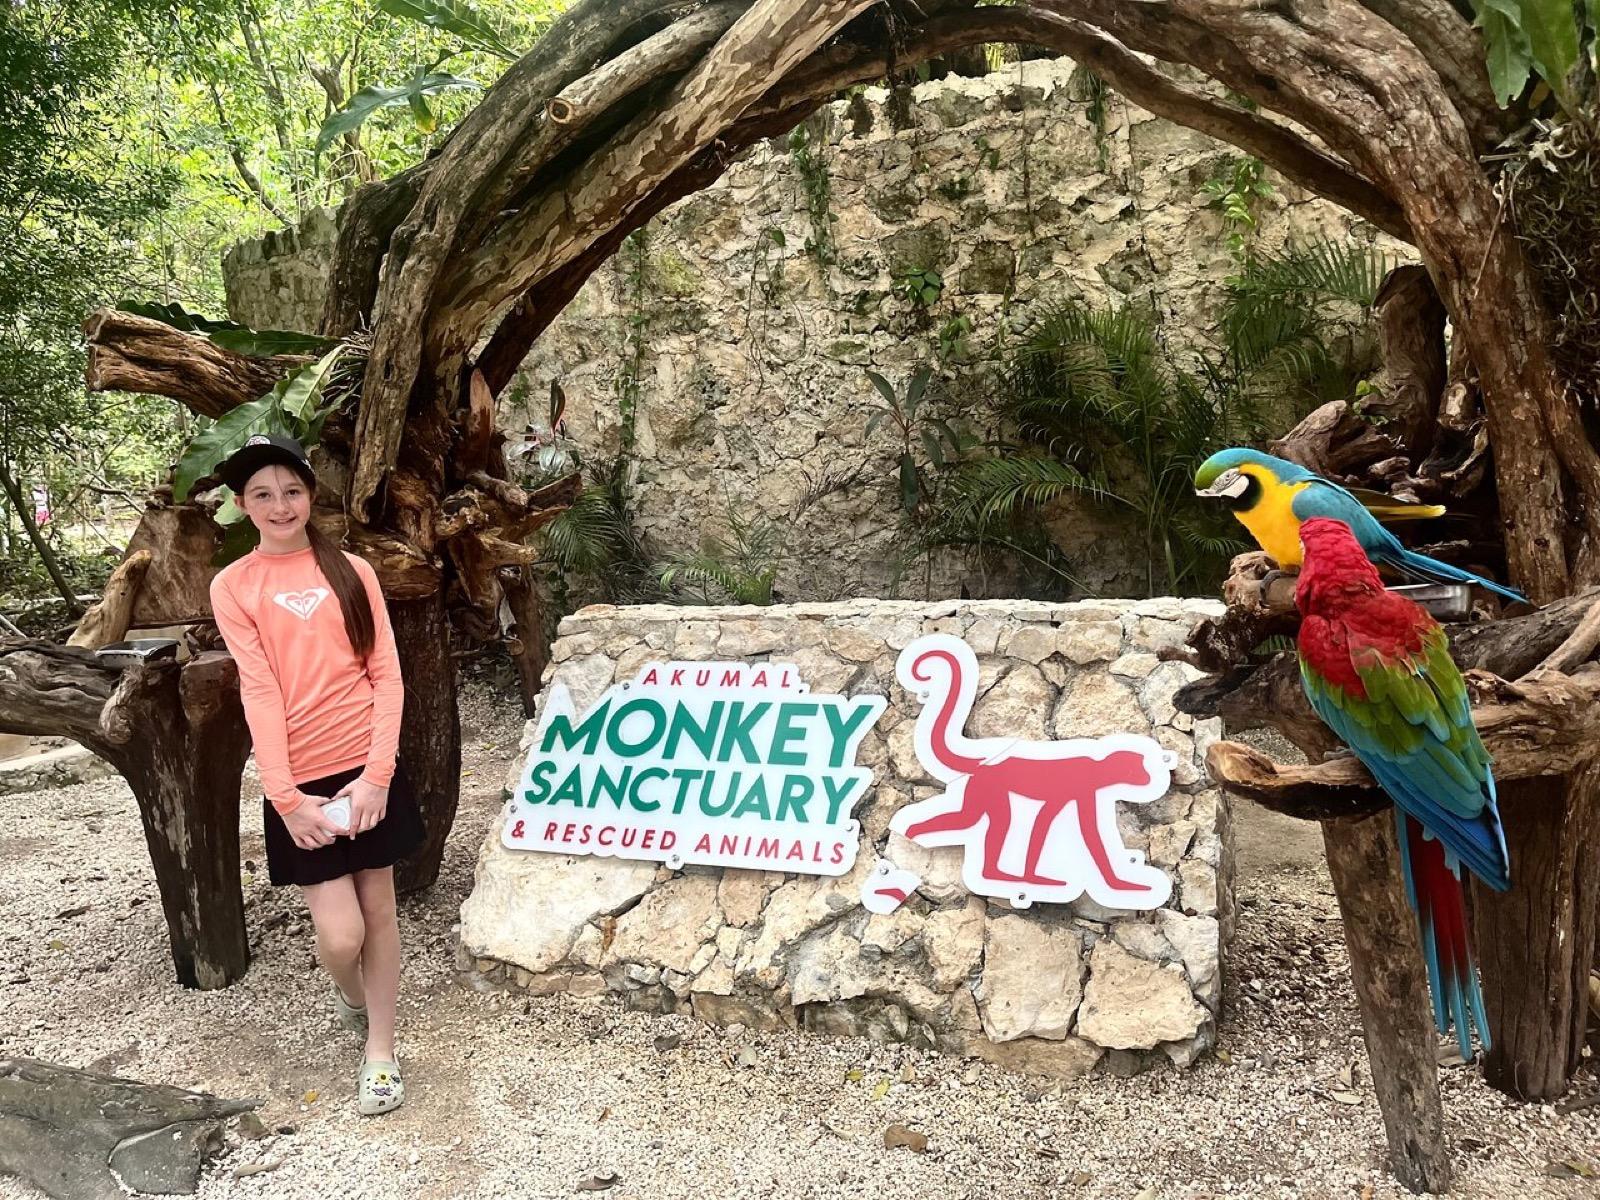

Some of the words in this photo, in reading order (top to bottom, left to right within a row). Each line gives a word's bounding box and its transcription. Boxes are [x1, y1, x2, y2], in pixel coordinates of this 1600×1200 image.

[642, 669, 791, 688] AKUMAL
[540, 698, 874, 768] MONKEY
[524, 760, 858, 825] SANCTUARY
[511, 820, 525, 839] &
[544, 822, 677, 850] RESCUED
[694, 834, 844, 865] ANIMALS
